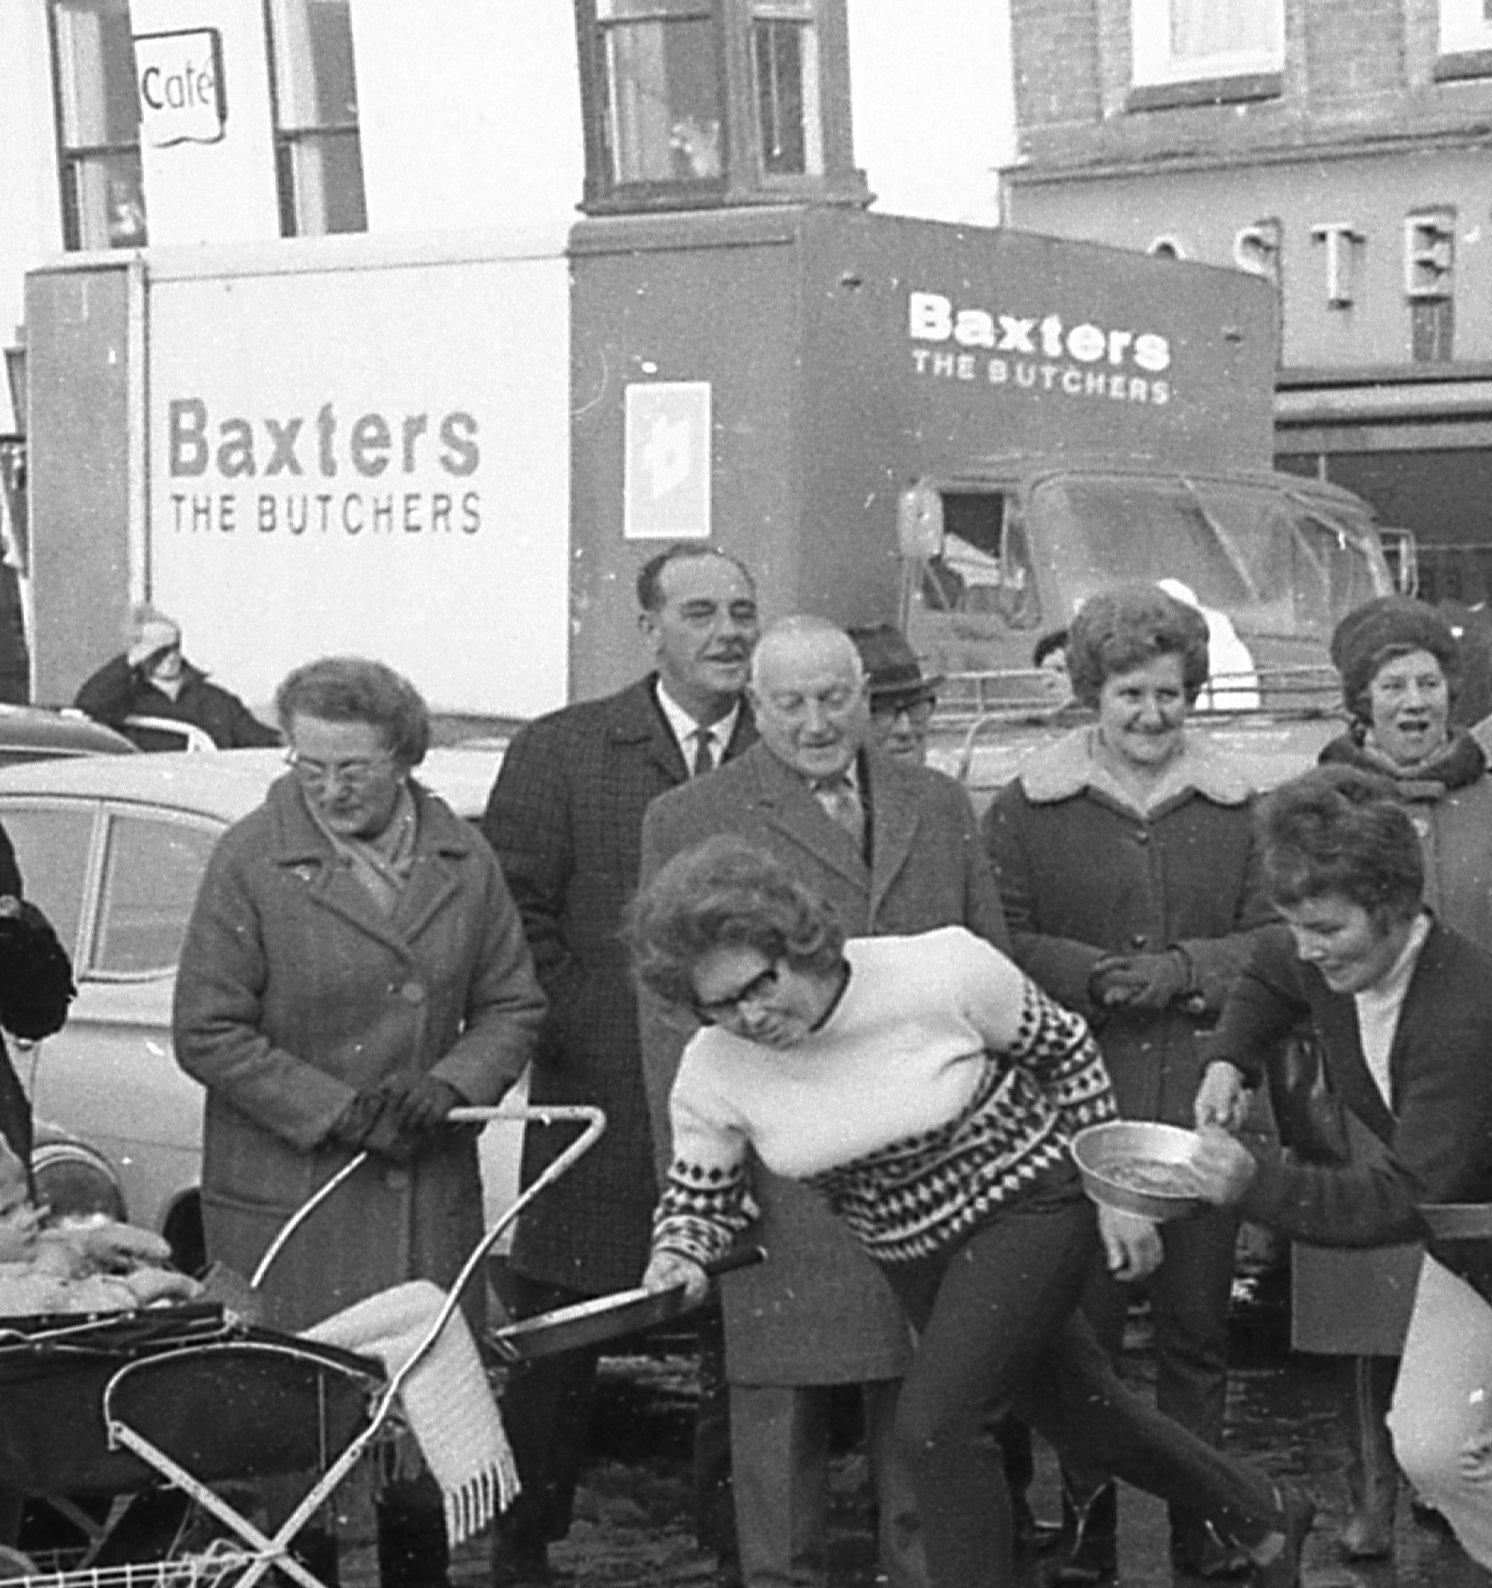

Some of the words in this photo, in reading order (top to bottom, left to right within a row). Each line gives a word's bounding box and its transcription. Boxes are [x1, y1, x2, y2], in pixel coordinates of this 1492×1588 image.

[910, 292, 1171, 371] Baxters
[912, 350, 975, 380] THE
[988, 358, 1169, 405] BUTCHERS
[169, 398, 480, 478] Baxters
[170, 494, 235, 532] THE
[257, 491, 481, 535] BUTCHERS
